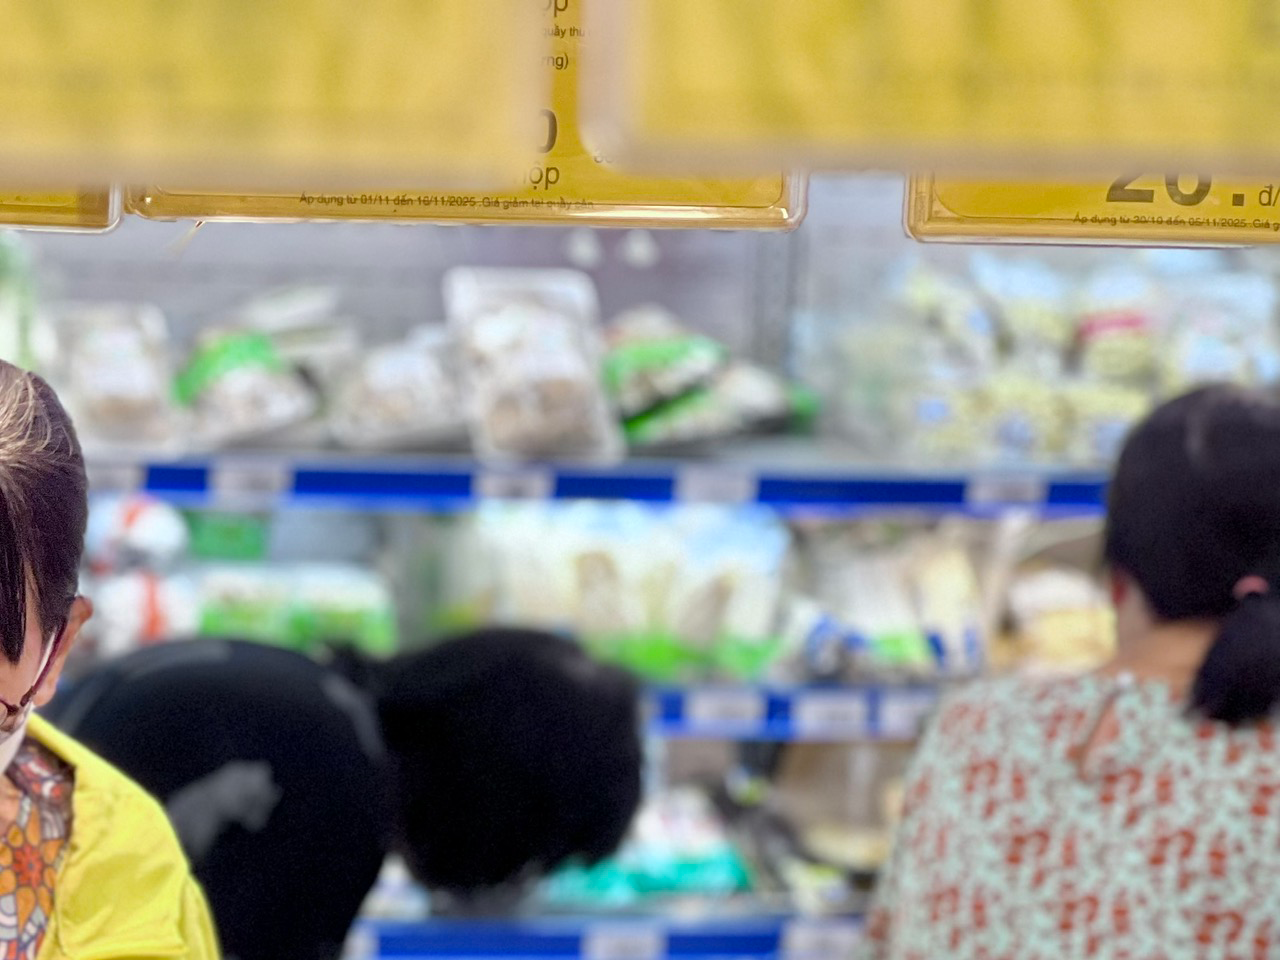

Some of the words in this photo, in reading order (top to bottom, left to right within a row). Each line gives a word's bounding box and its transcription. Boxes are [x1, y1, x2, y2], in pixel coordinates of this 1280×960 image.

[300, 192, 314, 205] Áp
[317, 194, 343, 206] dụng
[360, 194, 389, 205] 01/11
[393, 193, 413, 205] đến
[1073, 212, 1088, 225] Áp
[1090, 214, 1116, 226] dụng
[1166, 215, 1186, 226] đến
